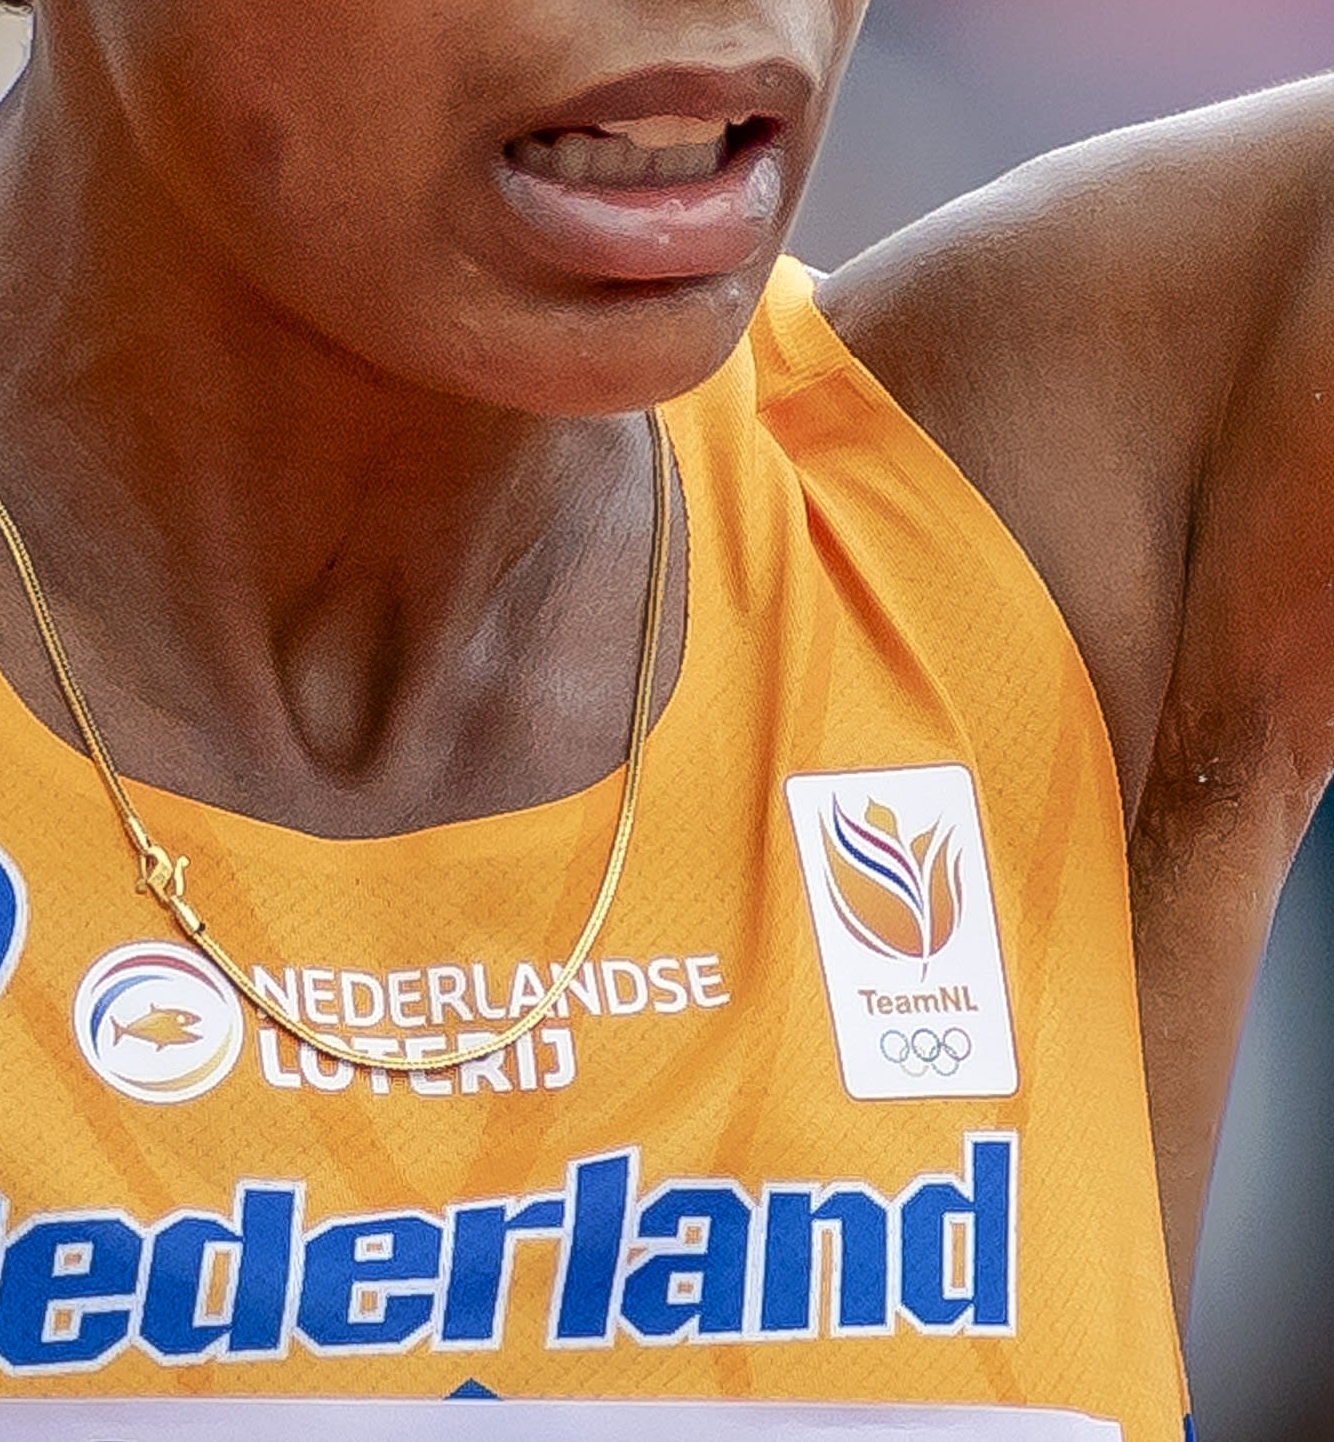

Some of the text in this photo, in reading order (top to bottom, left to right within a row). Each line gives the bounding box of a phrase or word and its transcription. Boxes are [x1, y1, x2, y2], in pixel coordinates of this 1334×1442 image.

[251, 954, 732, 1027] NEDERLANDSE
[857, 986, 979, 1016] TeamNL
[259, 1027, 578, 1096] LOTERIJ
